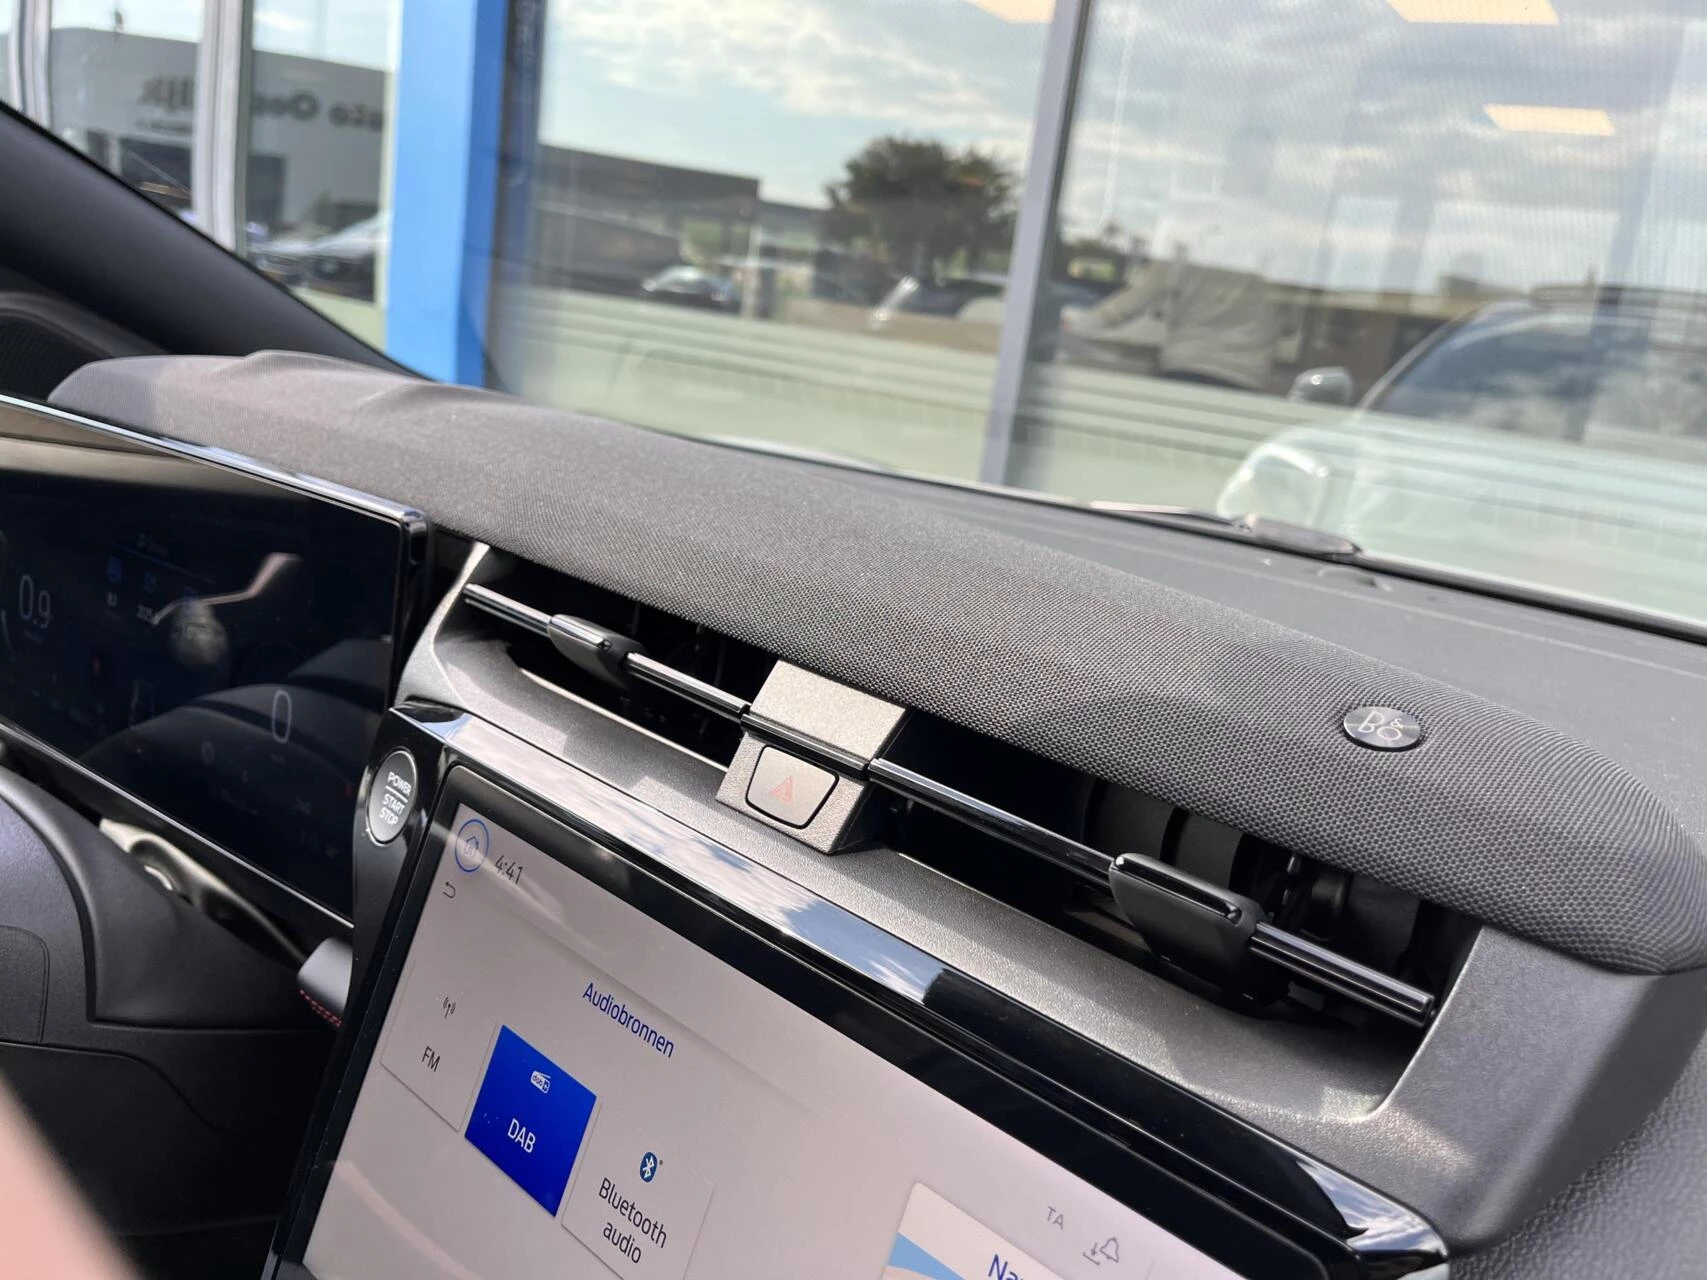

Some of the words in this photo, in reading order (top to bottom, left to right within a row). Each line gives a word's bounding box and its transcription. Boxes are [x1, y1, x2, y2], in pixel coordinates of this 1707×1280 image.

[19, 574, 51, 628] 0.9
[272, 690, 292, 743] 0
[387, 771, 412, 796] POWER
[379, 806, 399, 826] STOP
[382, 793, 405, 816] START
[494, 854, 523, 885] 4:41
[582, 982, 674, 1058] Audiobronnen
[421, 1046, 441, 1072] FM
[507, 1118, 536, 1153] DAB
[598, 1177, 667, 1248] Bluetooth
[1047, 1206, 1064, 1230] TA
[603, 1221, 642, 1264] audio
